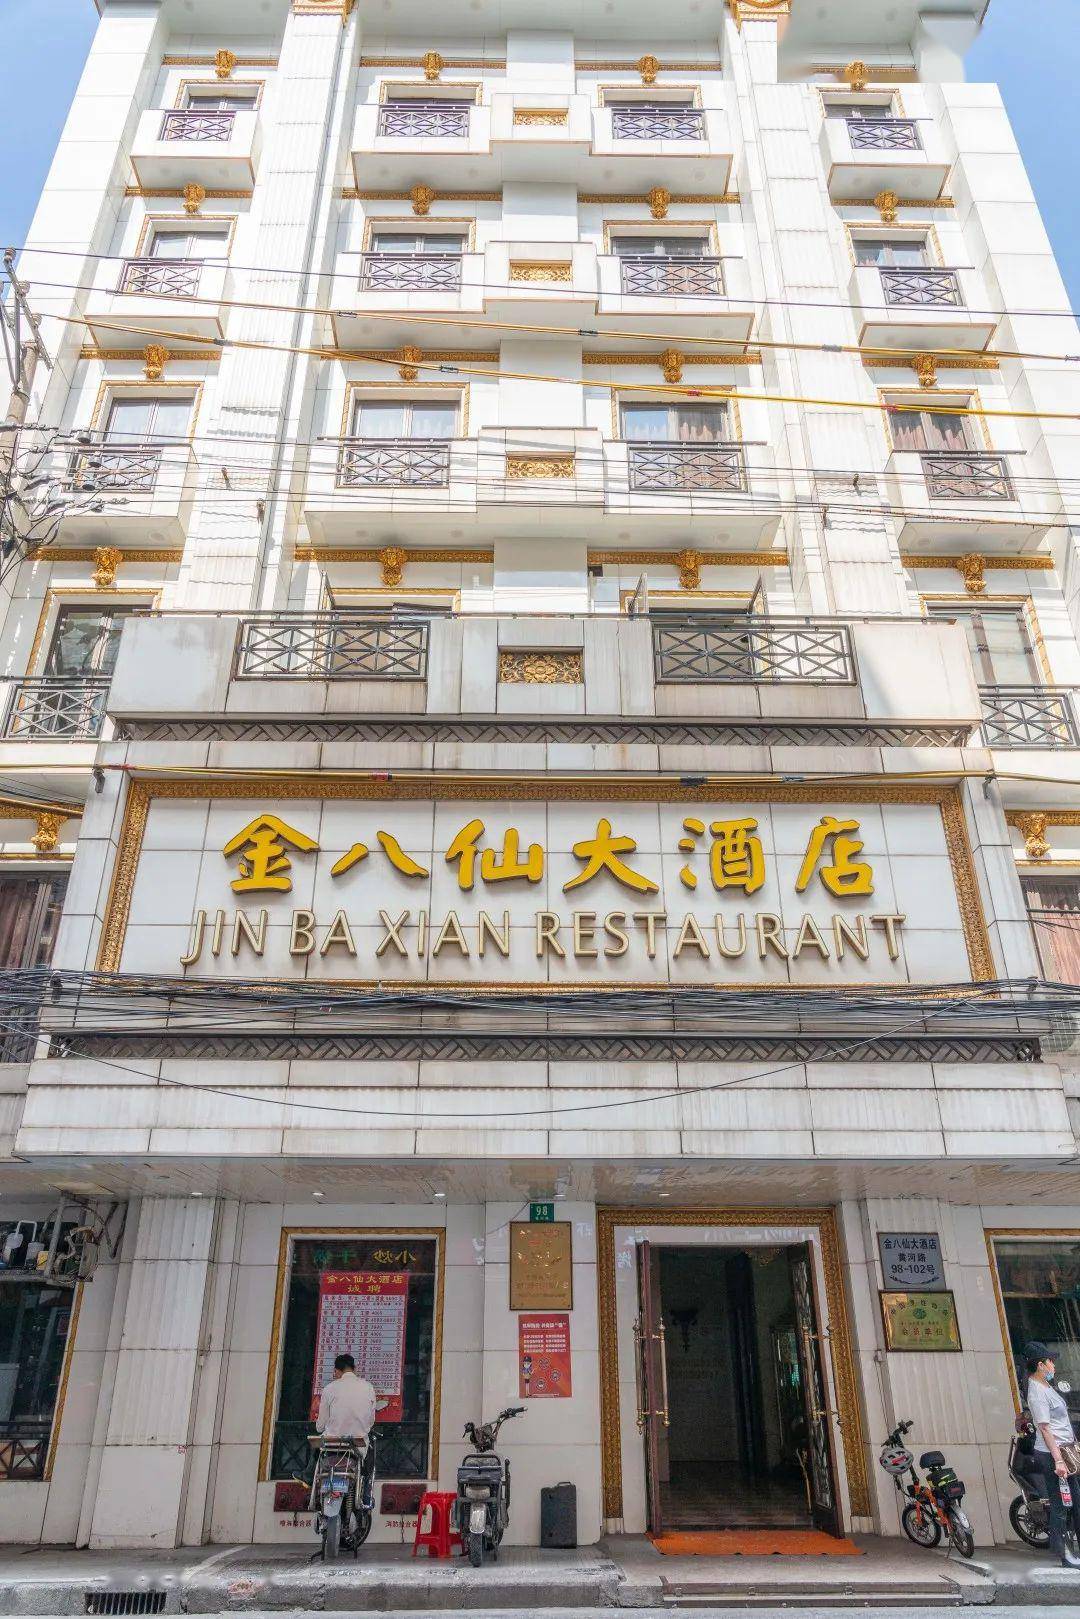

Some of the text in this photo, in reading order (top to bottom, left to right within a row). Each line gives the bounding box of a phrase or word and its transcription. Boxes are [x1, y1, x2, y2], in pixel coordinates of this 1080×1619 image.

[222, 814, 875, 898] 金八仙大酒店
[181, 908, 906, 966] JIN BA XIAN RESTAURANT
[536, 1205, 548, 1216] 98
[883, 1238, 937, 1250] 金八仙大酒店
[897, 1253, 927, 1263] 黄河路
[891, 1264, 936, 1275] 98-102号
